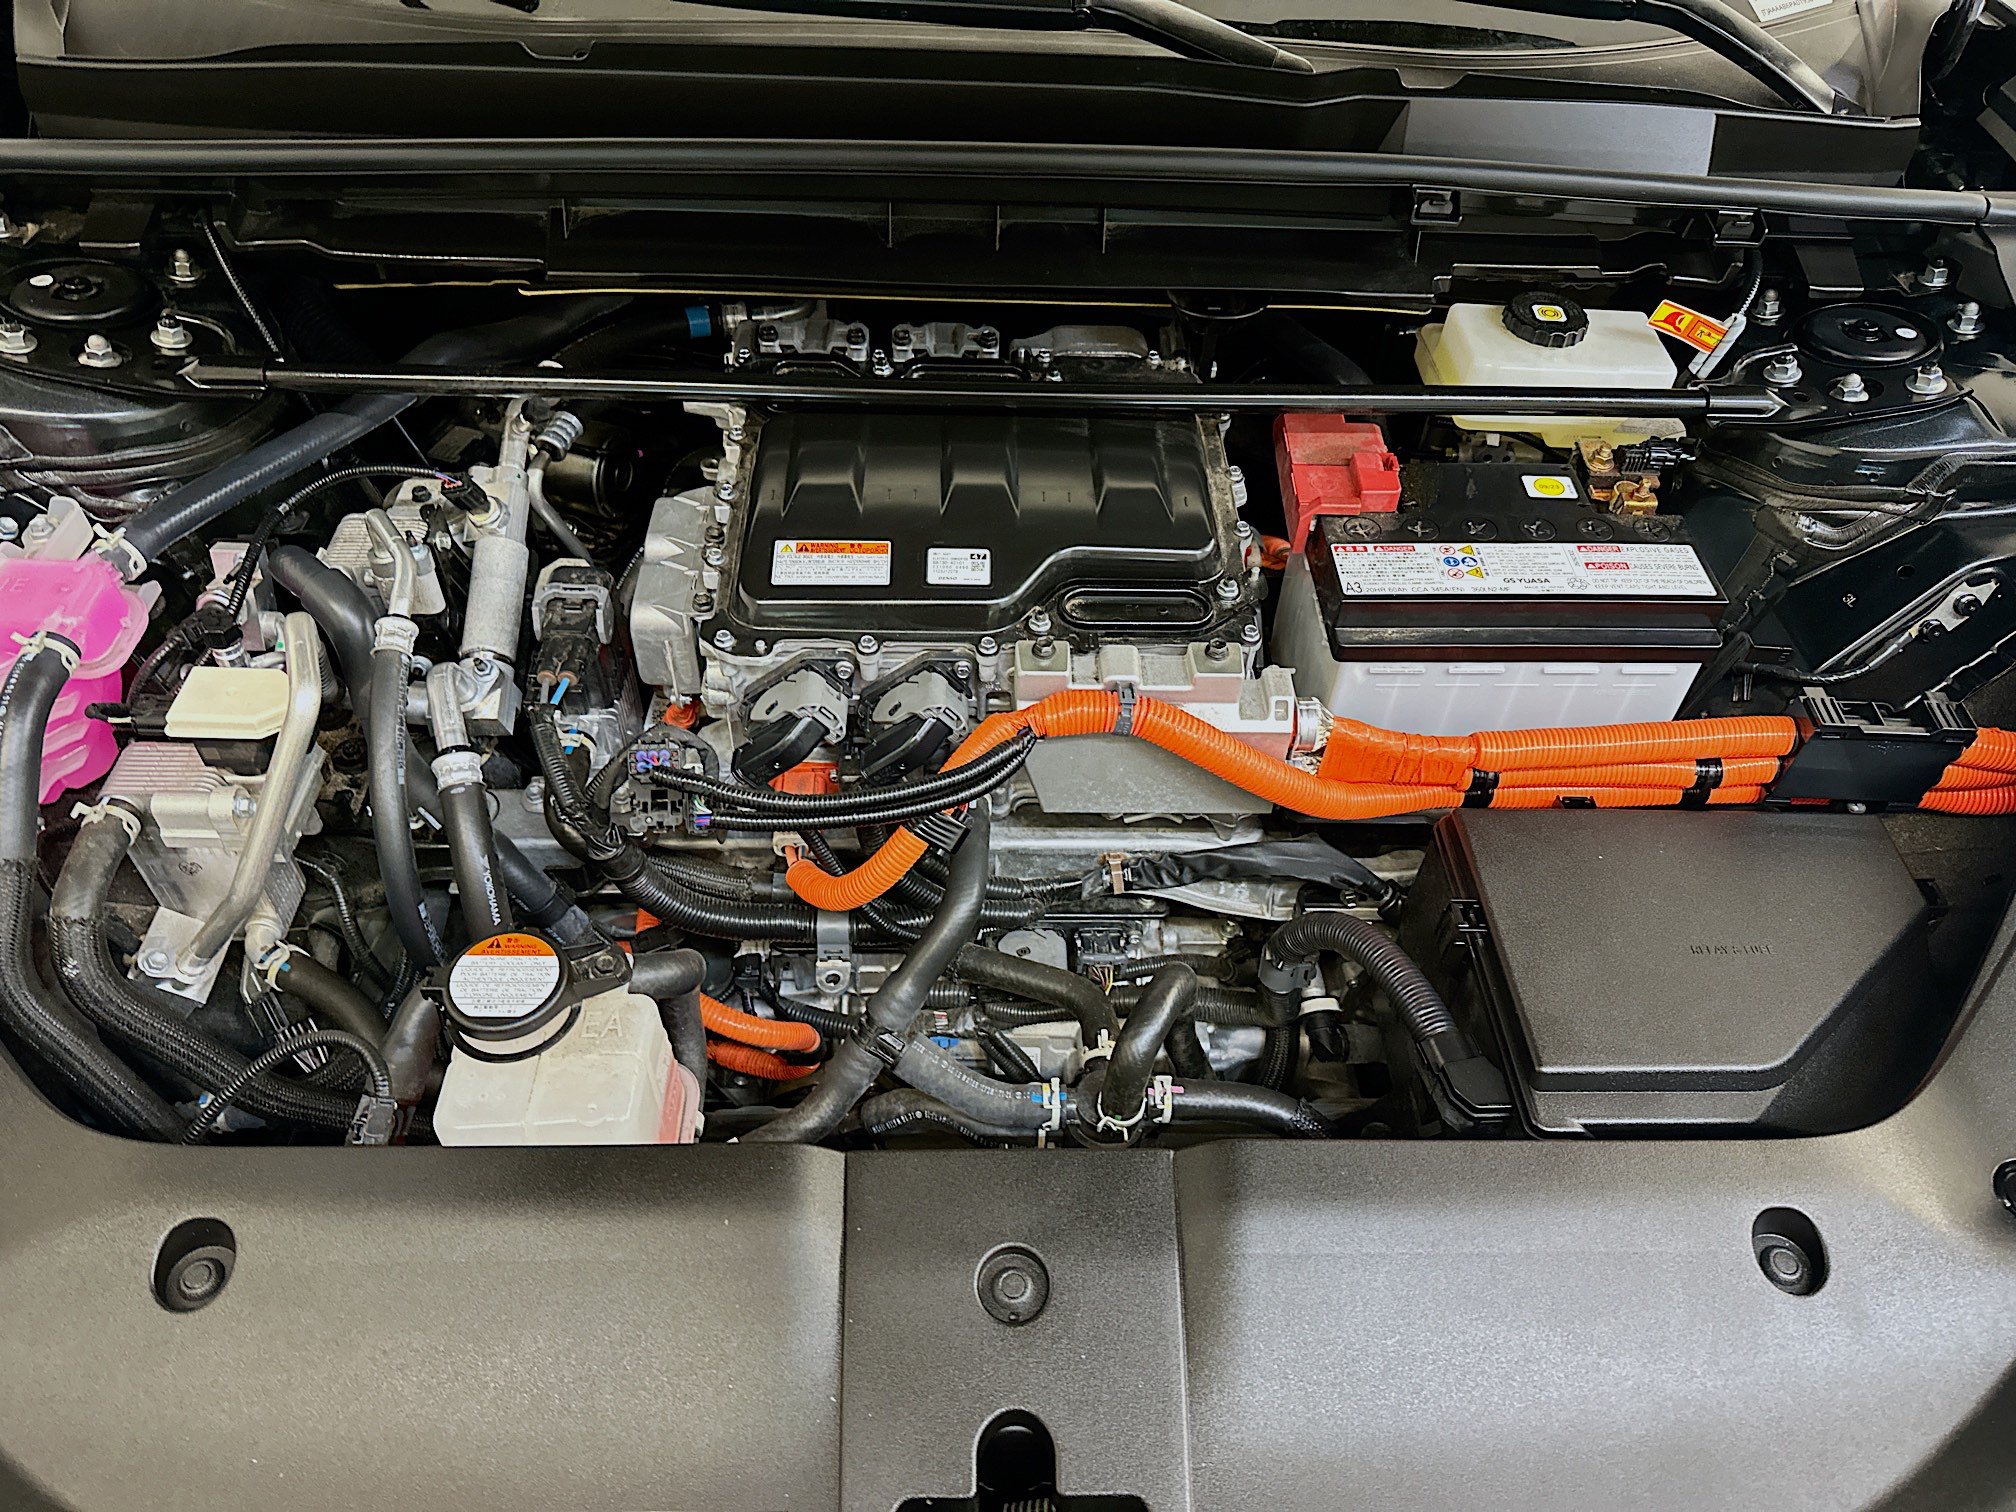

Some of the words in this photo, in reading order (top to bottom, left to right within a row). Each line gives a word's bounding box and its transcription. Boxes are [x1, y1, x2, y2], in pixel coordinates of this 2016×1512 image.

[1346, 581, 1363, 594] A3
[483, 869, 501, 926] YOKOHAMA
[581, 1009, 623, 1038] EA
